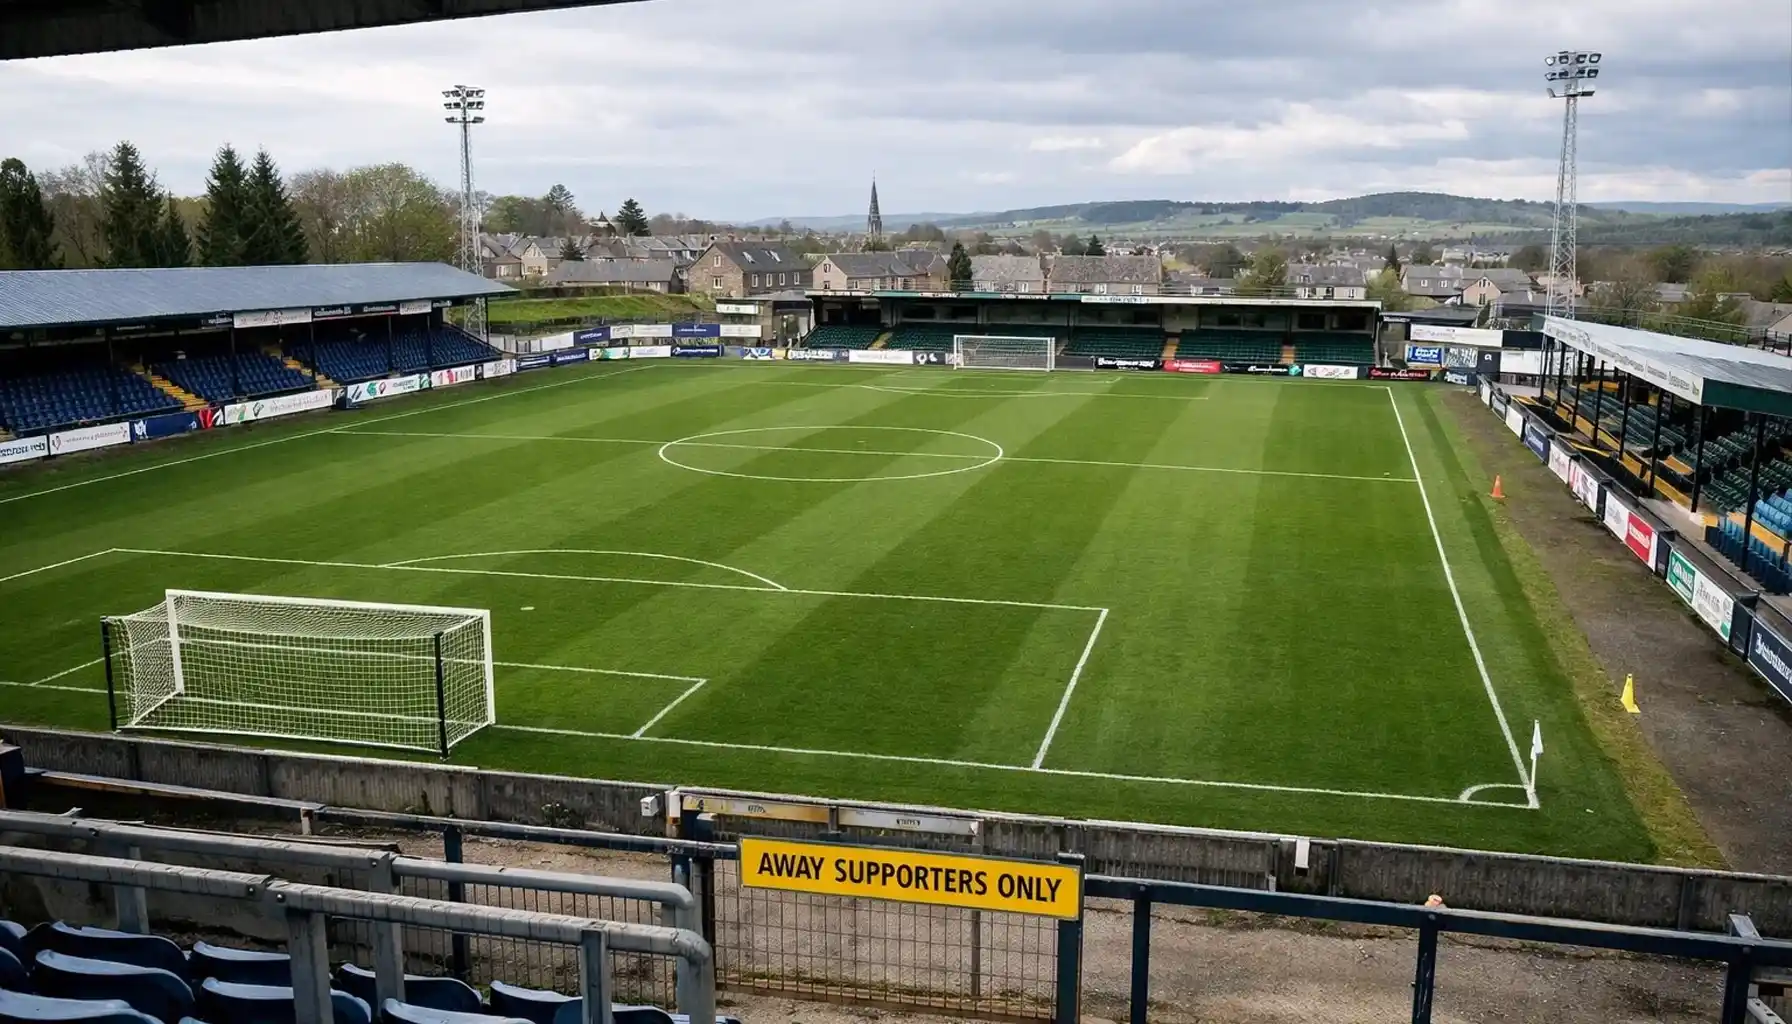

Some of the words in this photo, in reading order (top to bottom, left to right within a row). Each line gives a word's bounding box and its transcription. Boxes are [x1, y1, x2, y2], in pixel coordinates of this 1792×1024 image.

[758, 853, 824, 880] AWAY
[835, 858, 988, 896] SUPPORTERS
[998, 873, 1061, 903] ONLY
